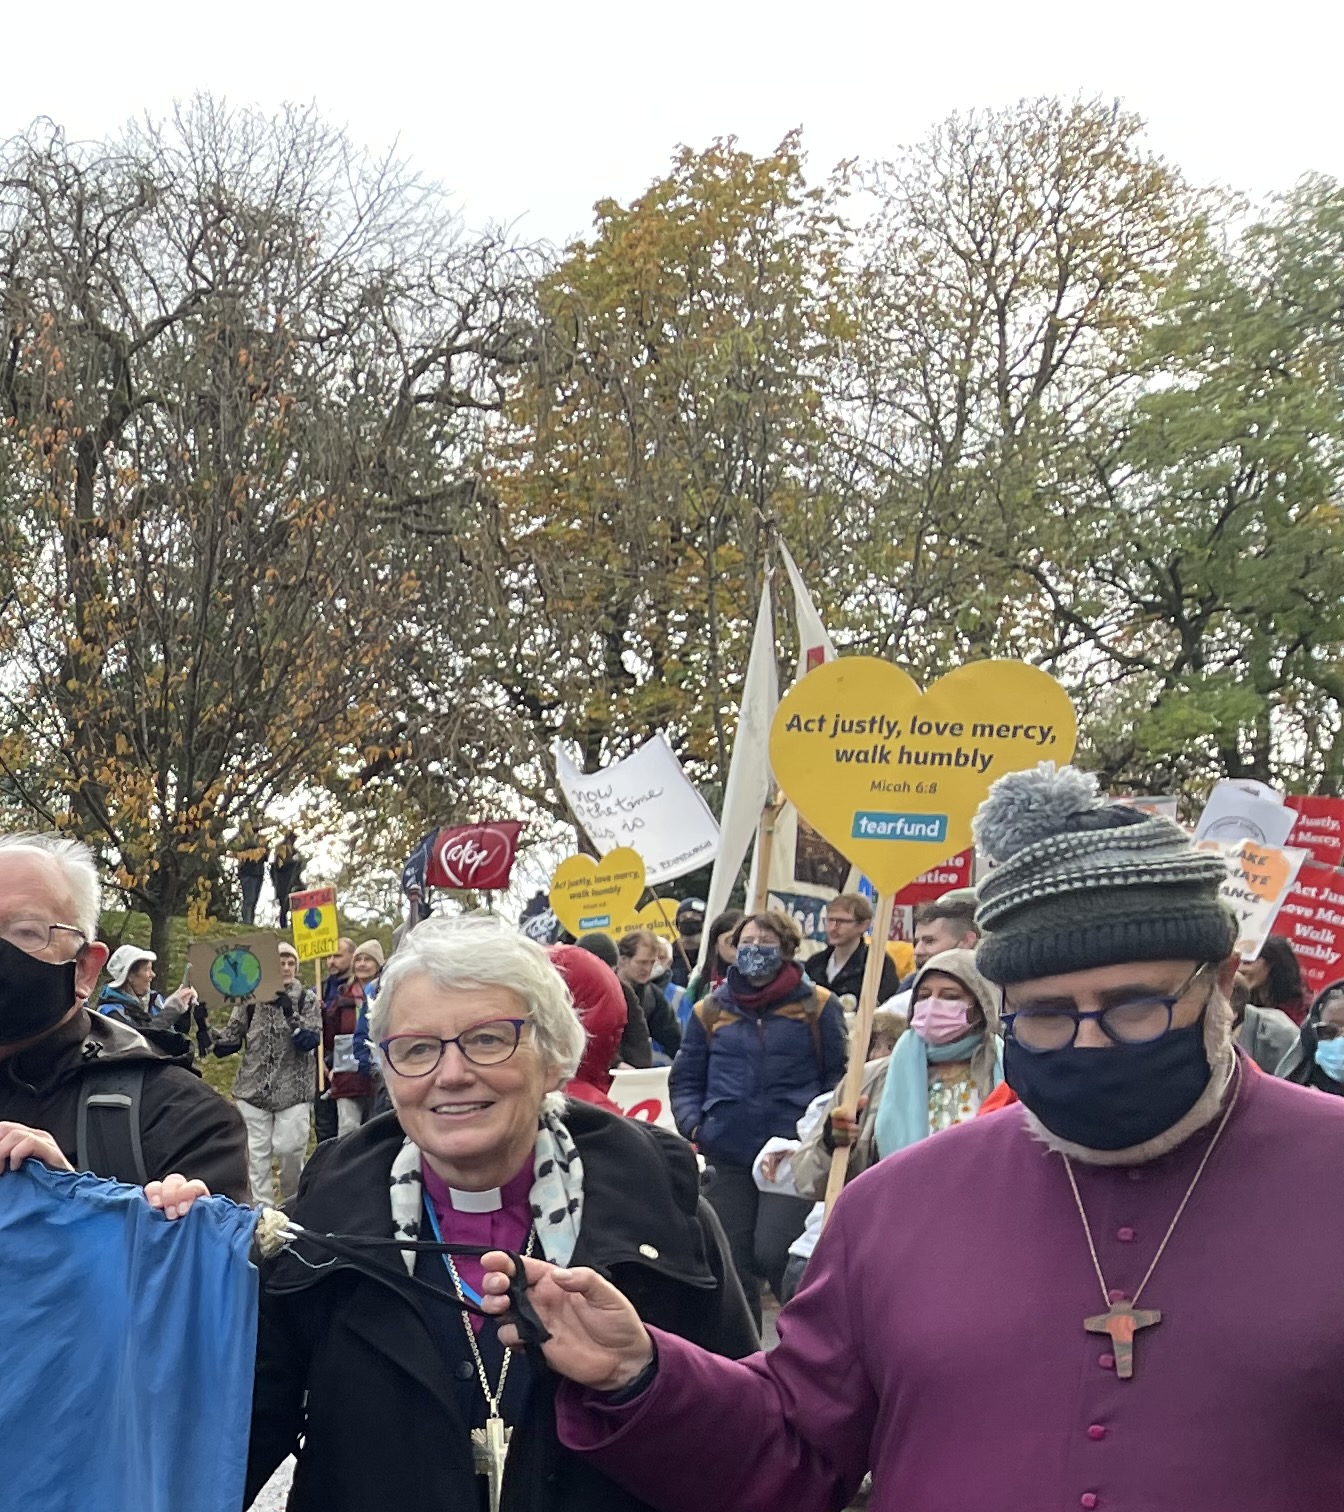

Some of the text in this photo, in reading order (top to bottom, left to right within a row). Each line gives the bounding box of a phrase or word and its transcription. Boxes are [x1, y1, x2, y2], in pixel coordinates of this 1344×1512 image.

[785, 714, 1057, 745] Act justly, love mercy,
[835, 745, 994, 773] walk humbly
[870, 779, 939, 795] Micah 6:8
[858, 815, 941, 838] tearfund
